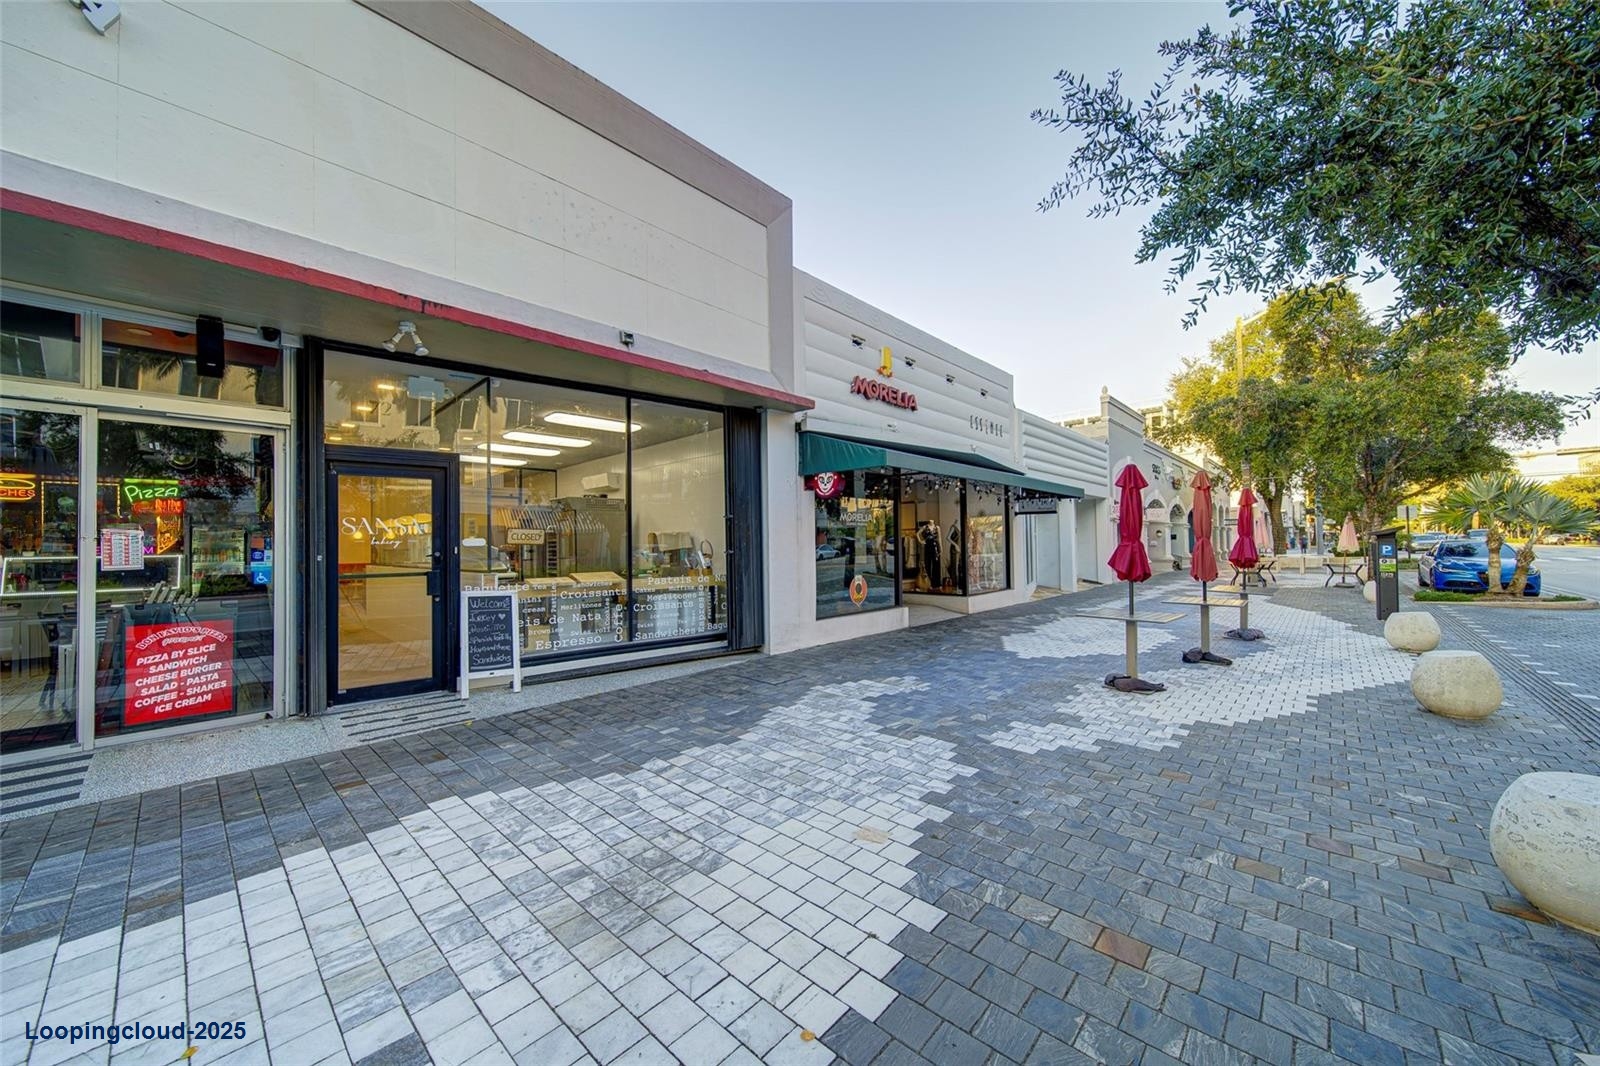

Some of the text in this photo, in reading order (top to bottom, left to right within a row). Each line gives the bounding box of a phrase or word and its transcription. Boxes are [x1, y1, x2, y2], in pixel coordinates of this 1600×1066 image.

[850, 376, 918, 412] MORELIA
[341, 517, 424, 535] SANSA
[511, 533, 541, 541] CLOSED
[560, 589, 628, 599] Croissants
[633, 600, 694, 612] Croissants
[548, 614, 565, 625] de
[573, 612, 602, 623] Nata
[535, 635, 602, 651] Espresso
[635, 628, 696, 640] Sandwiches
[137, 644, 216, 666] PIZZA BY SLICE
[149, 655, 207, 674] SANDWICH
[135, 662, 222, 687] CHEESE BURGER
[141, 681, 178, 696] SALAD
[187, 672, 219, 686] PASTA
[135, 692, 178, 708] COFFEE
[186, 680, 227, 696] SHAKES
[155, 693, 212, 714] ICE CREAM
